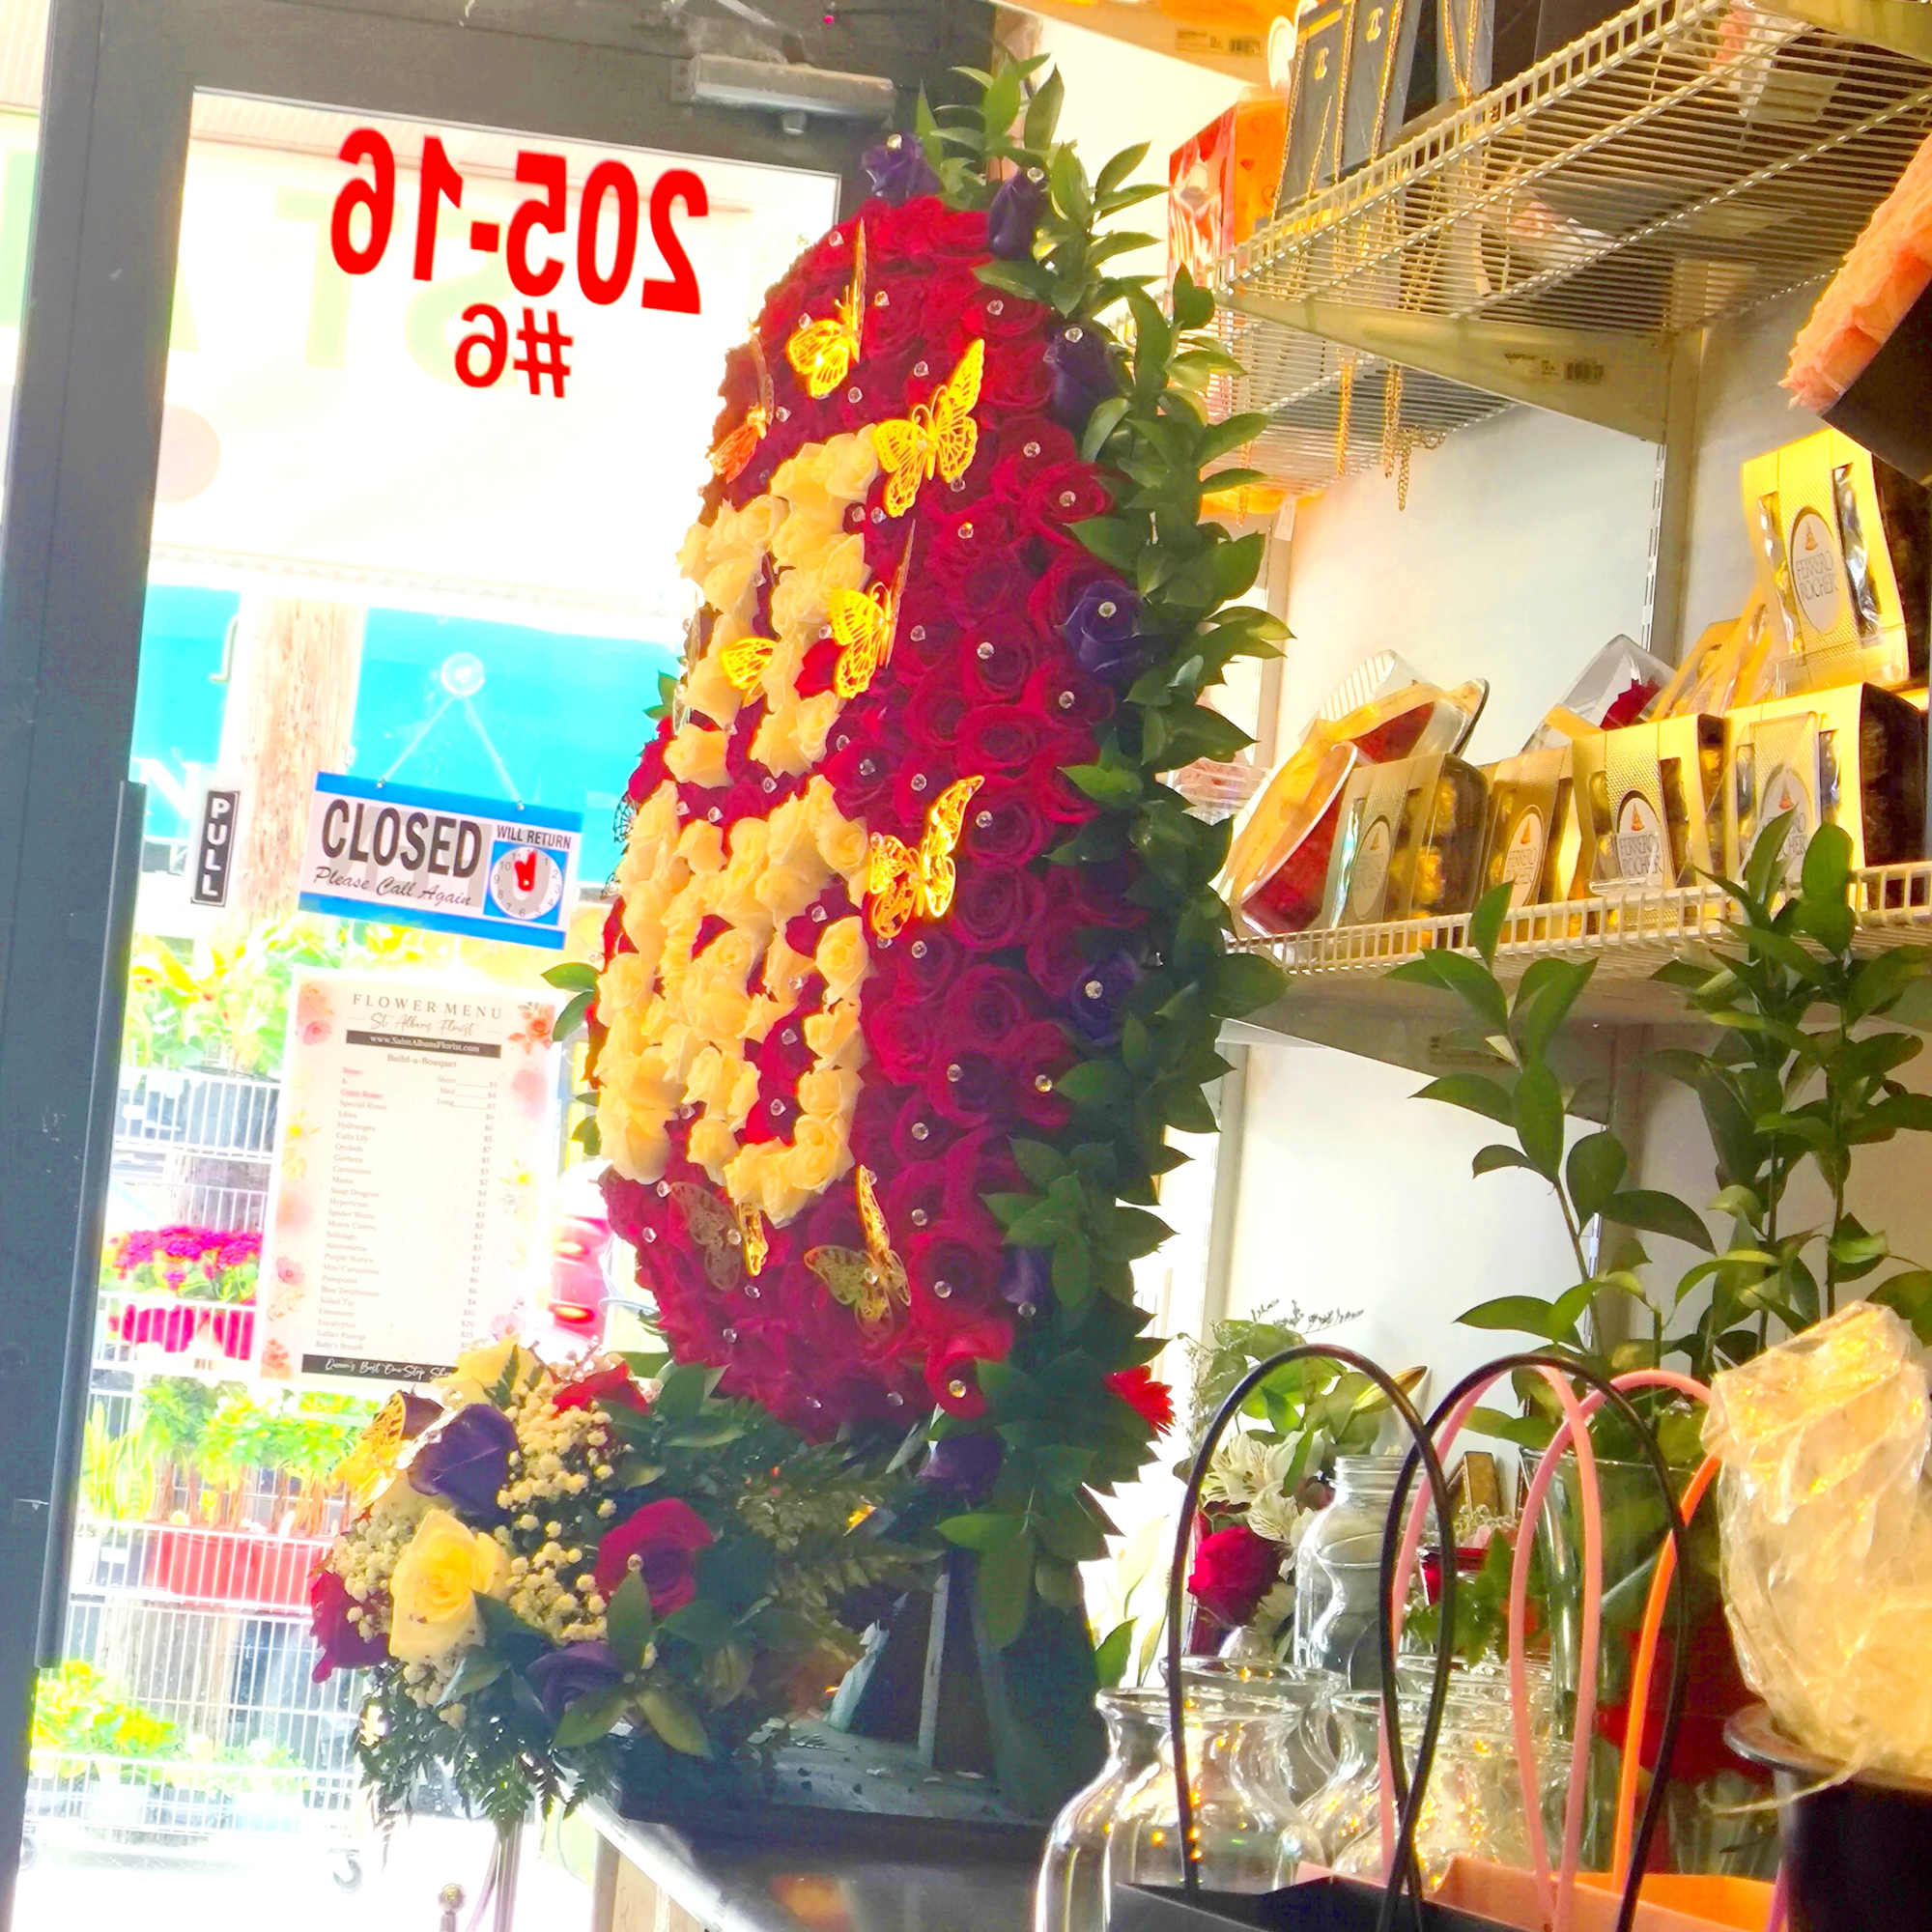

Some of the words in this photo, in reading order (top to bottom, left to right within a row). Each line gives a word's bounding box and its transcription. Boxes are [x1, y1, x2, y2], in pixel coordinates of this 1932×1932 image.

[201, 798, 231, 895] PULL
[322, 798, 482, 879] CLOSED
[497, 825, 524, 842] WILL
[527, 829, 572, 850] RETURN
[314, 866, 371, 892] Please
[376, 876, 414, 896] Call
[418, 886, 470, 906] Again
[353, 993, 437, 1013] FLOWER
[445, 1004, 501, 1019] MENU
